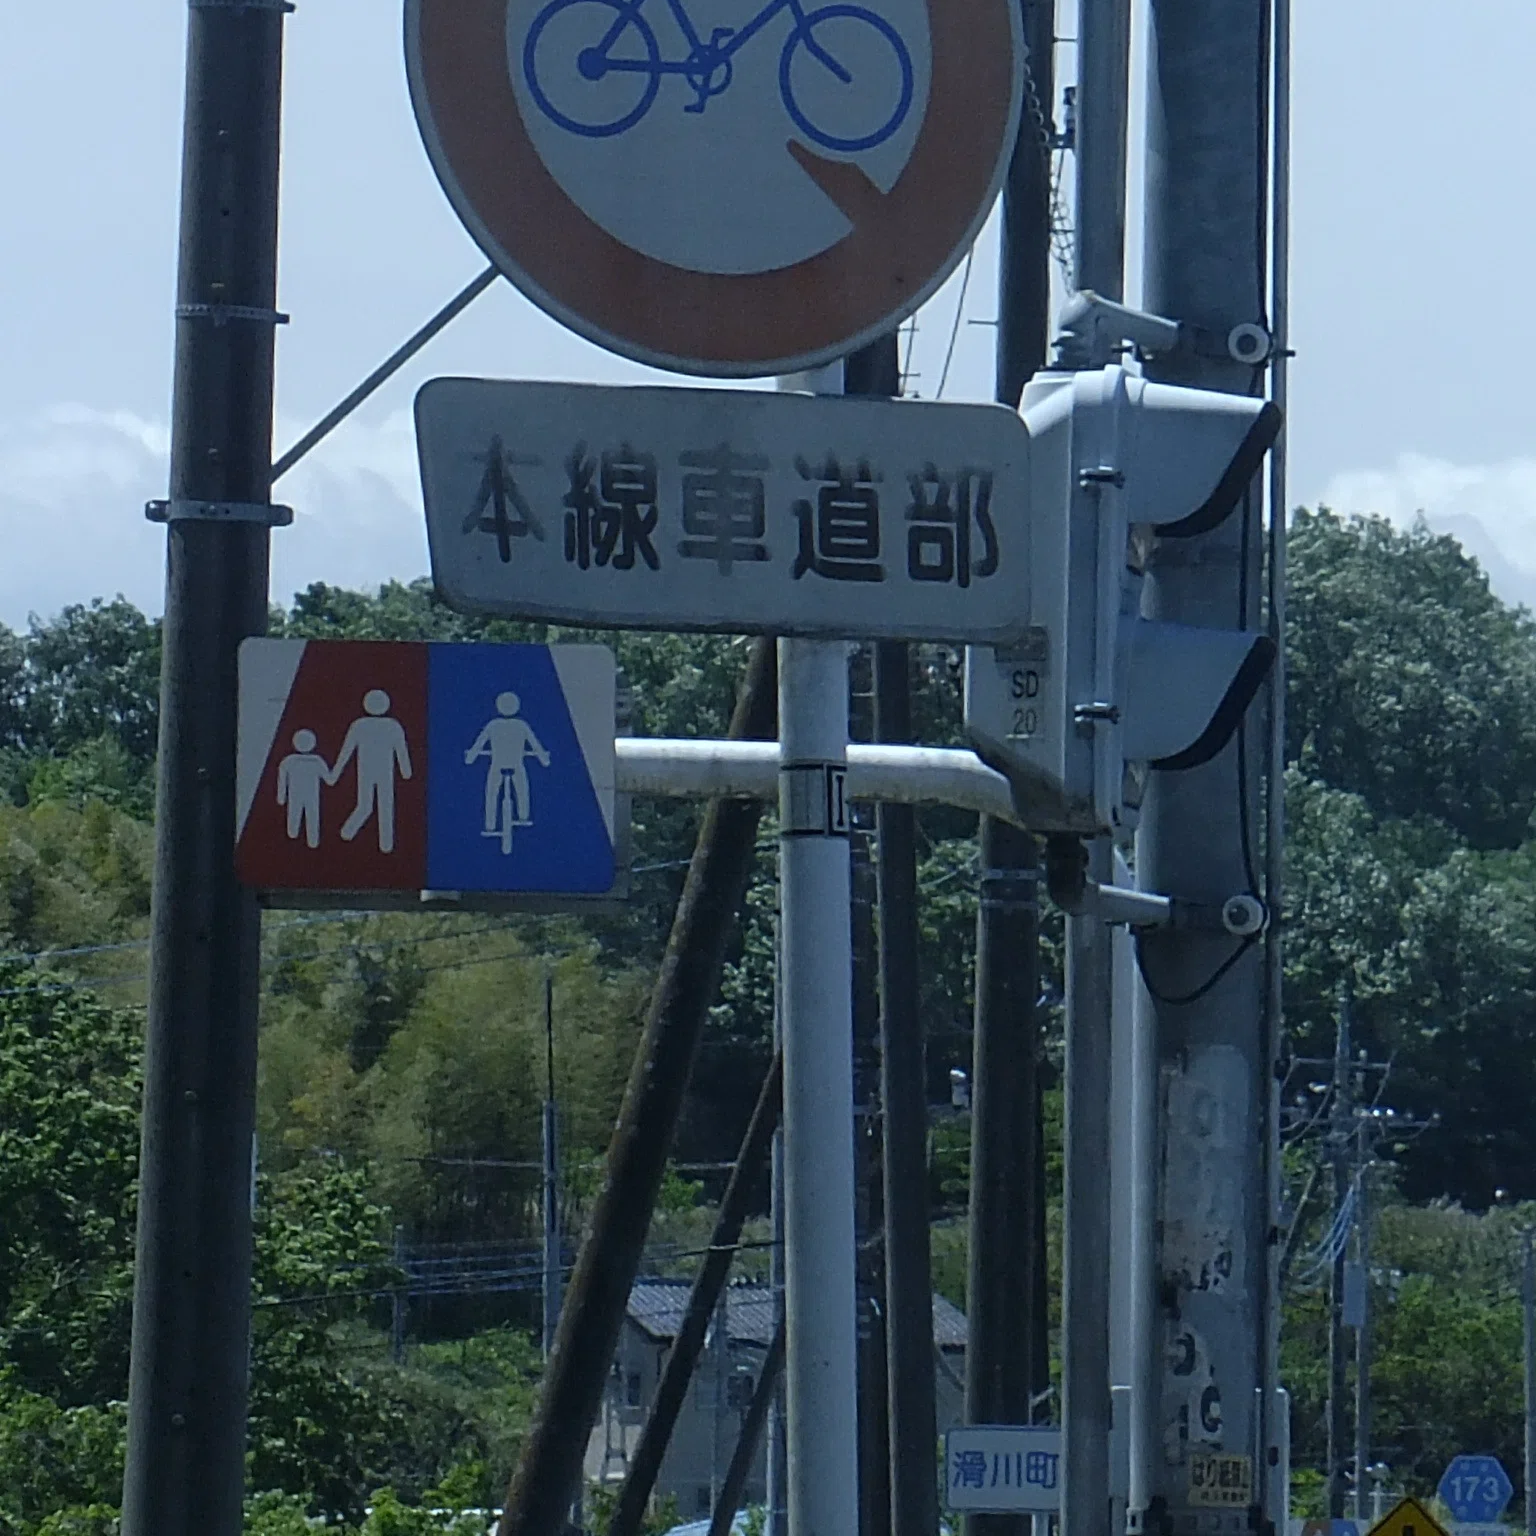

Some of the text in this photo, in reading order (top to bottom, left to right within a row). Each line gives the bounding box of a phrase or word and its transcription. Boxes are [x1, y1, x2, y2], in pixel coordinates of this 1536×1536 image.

[455, 434, 1000, 589] 本線車道部
[1011, 669, 1039, 699] SD
[1012, 708, 1038, 735] 20
[953, 1451, 1060, 1489] 滑川町
[1450, 1477, 1499, 1503] 173
